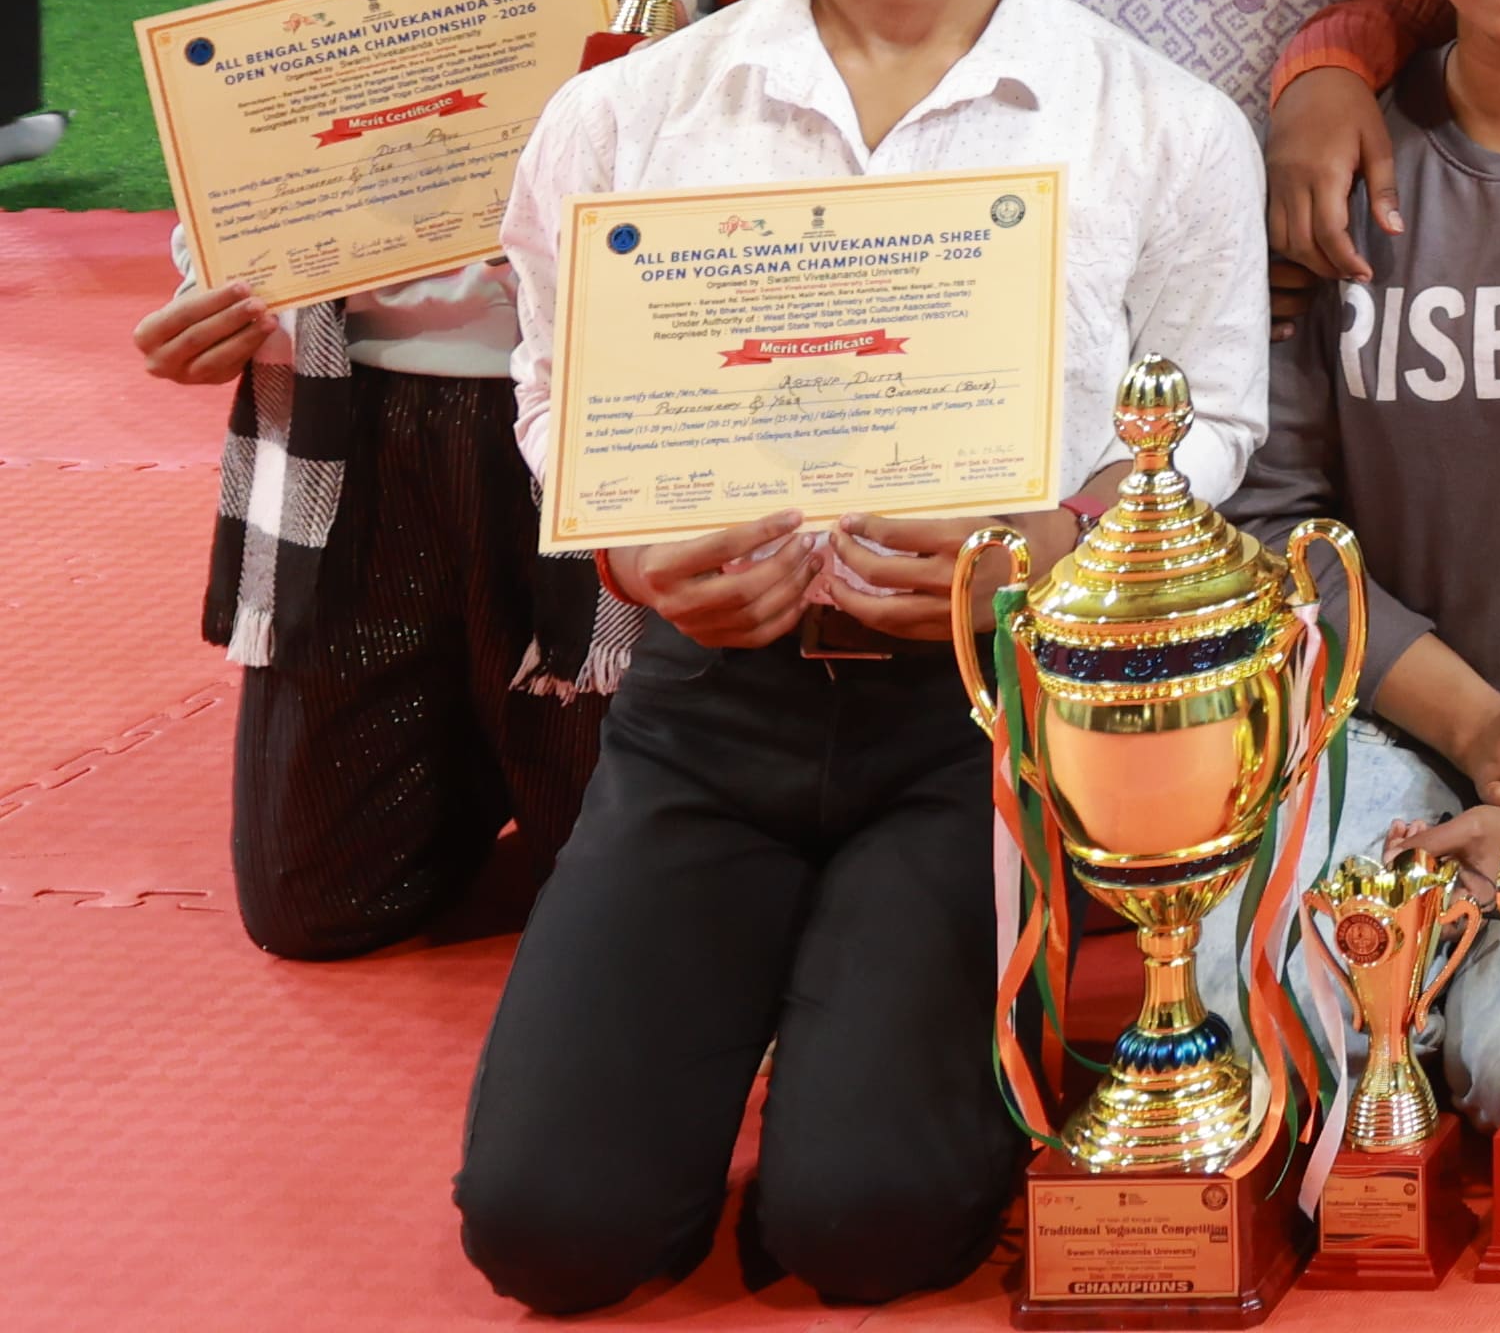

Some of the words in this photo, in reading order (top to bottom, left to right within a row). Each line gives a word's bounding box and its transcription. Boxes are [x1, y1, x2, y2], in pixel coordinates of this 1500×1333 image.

[214, 57, 241, 72] ALL
[246, 41, 306, 64] BENGAL
[310, 26, 367, 48] SWAMI
[224, 67, 265, 85] OPEN
[270, 44, 360, 73] YOGASANA
[362, 13, 491, 51] CHAMPIONSHIP
[347, 112, 385, 131] Merit
[383, 96, 456, 123] Certificate
[634, 252, 665, 265] ALL
[669, 246, 738, 263] BENGAL
[742, 242, 804, 257] SWAMI
[809, 233, 935, 253] VIVEKANANDA
[940, 229, 990, 243] SHREE
[640, 268, 687, 282] OPEN
[691, 260, 792, 278] YOGASANA
[796, 250, 929, 271] CHAMPIONSHIP
[759, 340, 798, 355] Merit
[800, 334, 874, 354] Certificate
[1038, 1225, 1100, 1236] Traditional
[1074, 1281, 1189, 1293] CHAMPIONS
